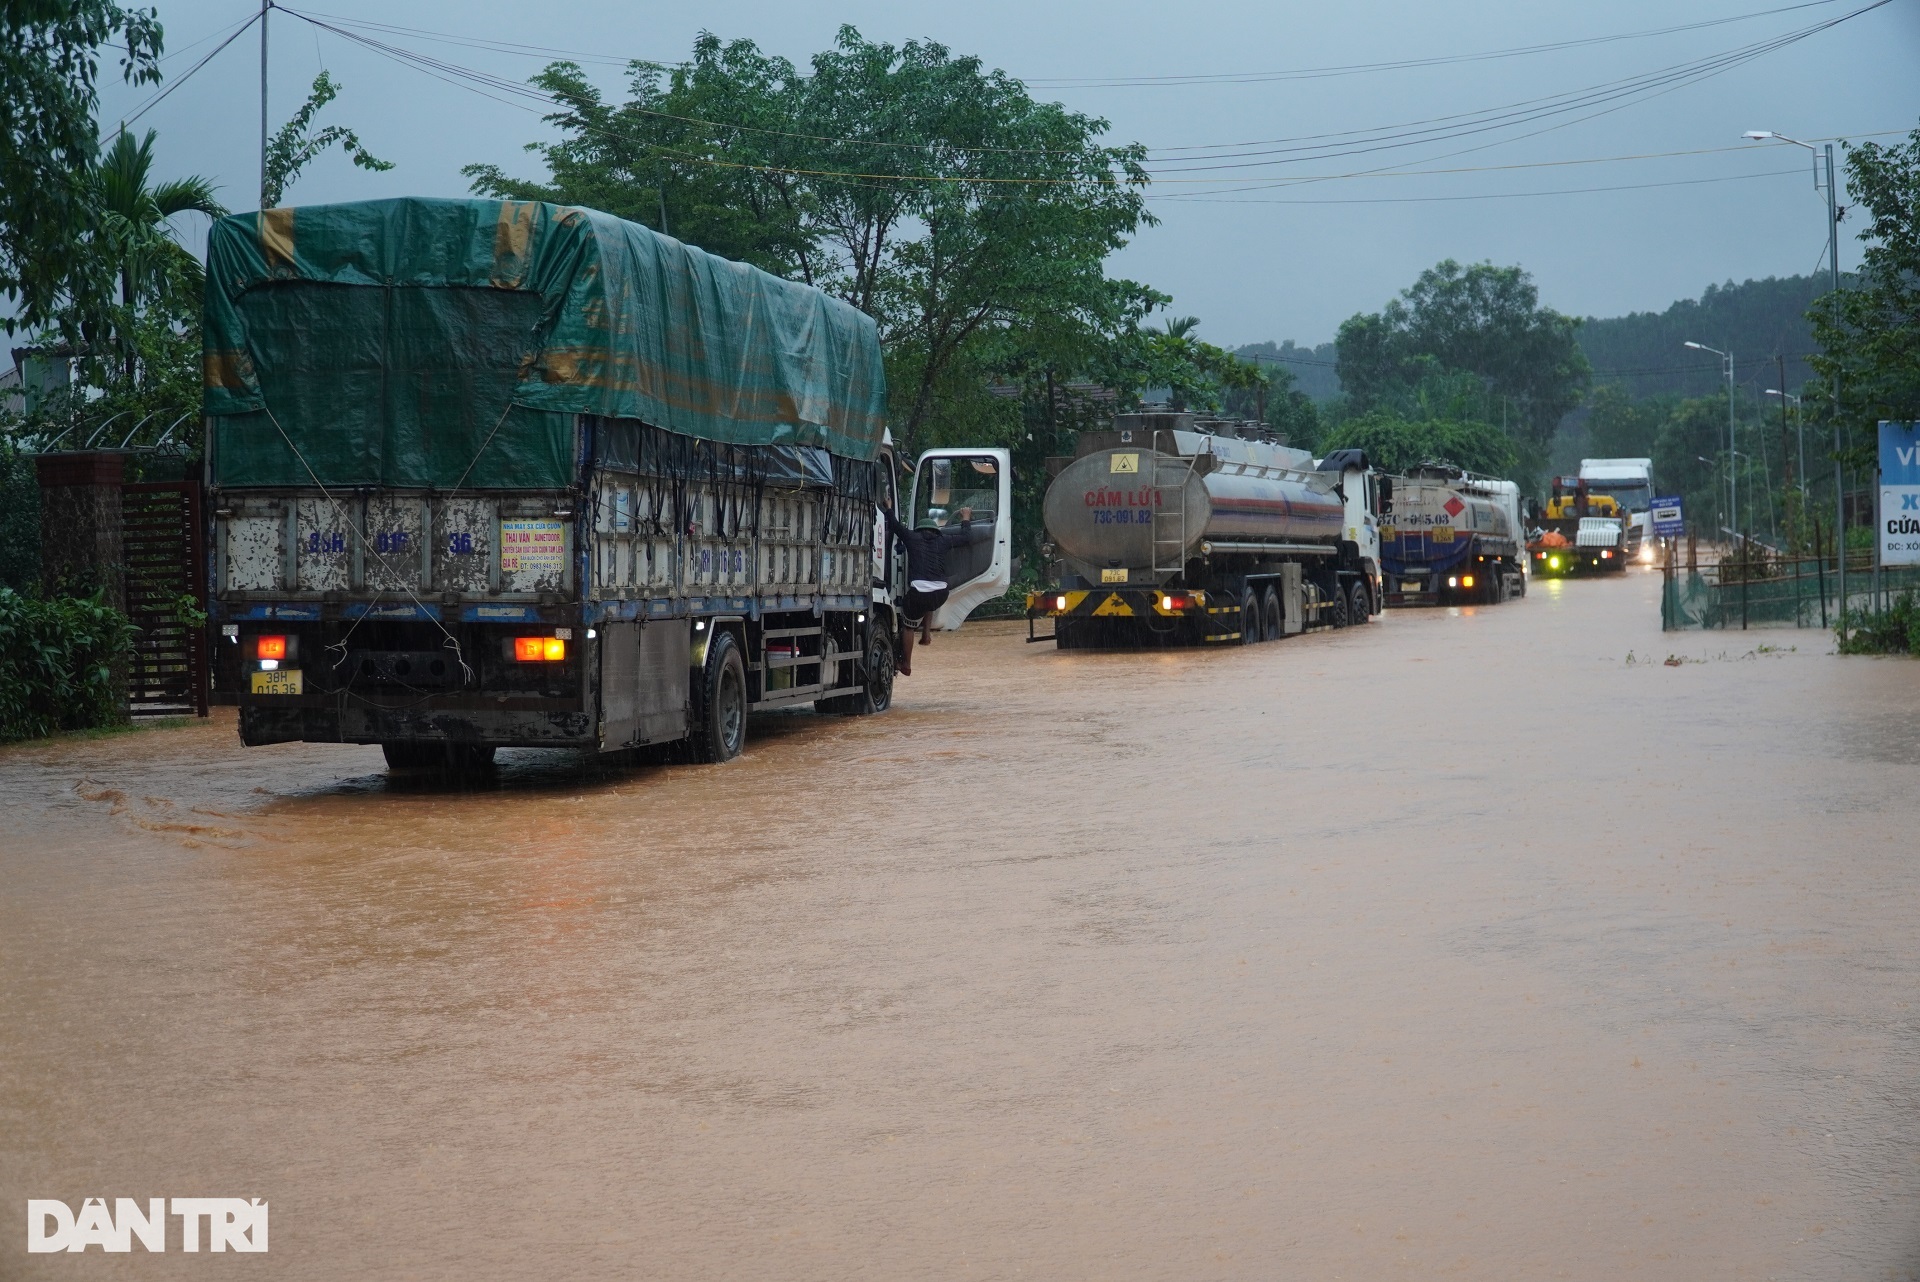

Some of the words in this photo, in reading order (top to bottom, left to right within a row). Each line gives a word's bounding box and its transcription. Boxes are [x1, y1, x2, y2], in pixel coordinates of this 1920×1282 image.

[1085, 486, 1122, 507] CẤM
[1128, 485, 1162, 507] LỬA
[1902, 494, 1920, 510] X
[1093, 509, 1152, 524] 73C-091.82
[449, 532, 472, 554] 36
[266, 671, 288, 683] 38H
